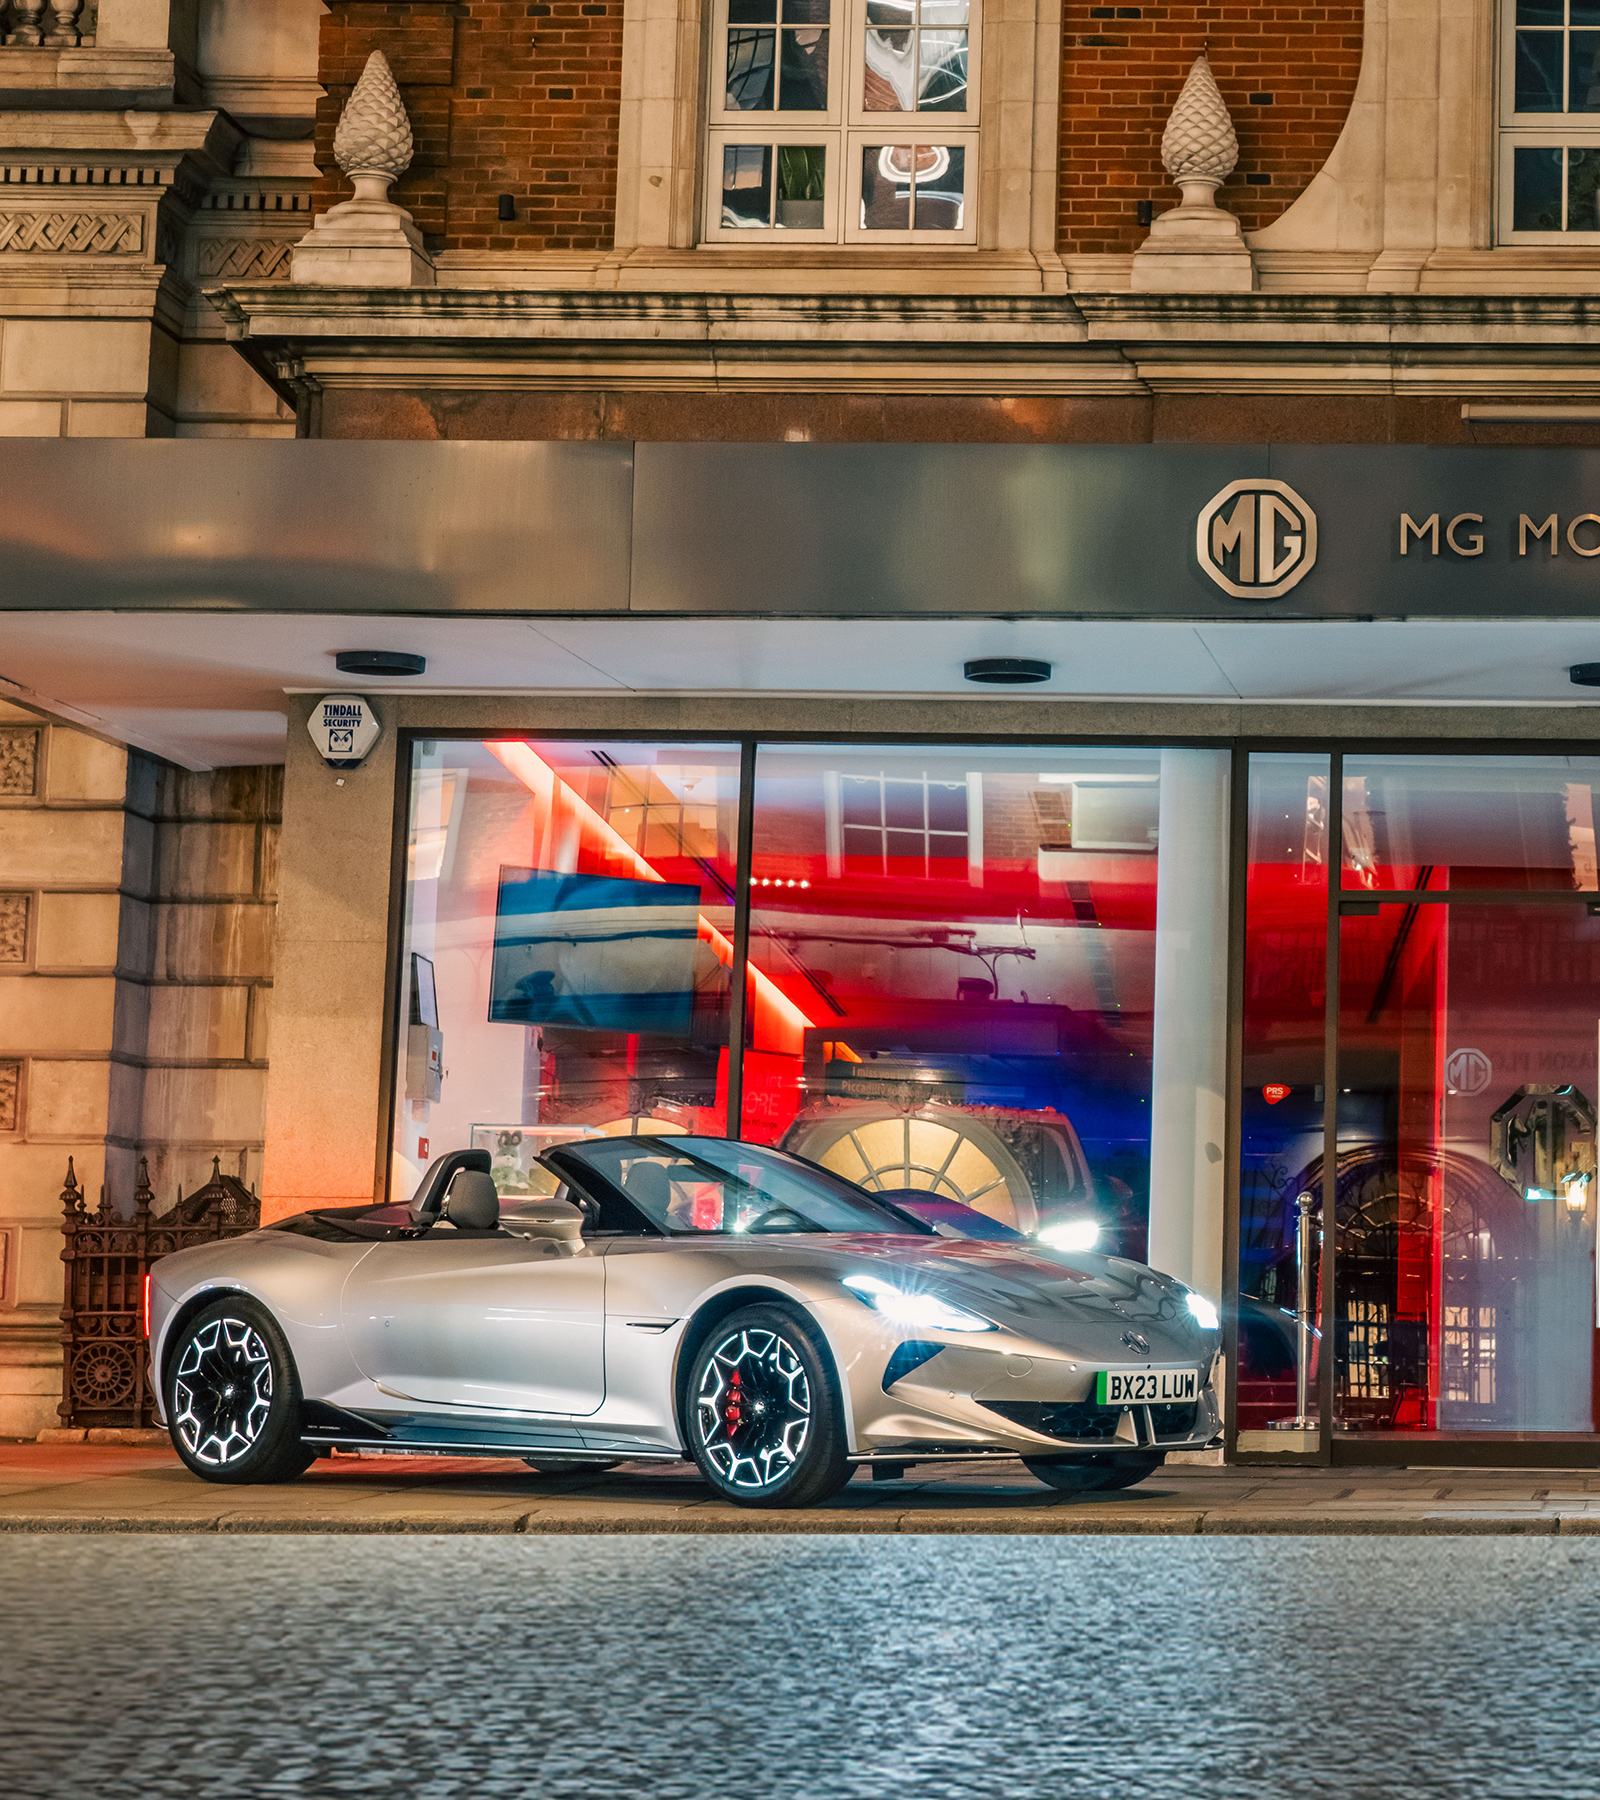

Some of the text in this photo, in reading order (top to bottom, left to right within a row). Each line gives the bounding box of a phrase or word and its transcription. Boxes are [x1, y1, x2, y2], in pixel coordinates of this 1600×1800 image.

[1211, 492, 1305, 585] MG
[1400, 512, 1484, 556] MG
[323, 704, 362, 716] TINDALL
[323, 719, 362, 727] SECURITY
[857, 1067, 877, 1079] miss
[1449, 1053, 1487, 1091] MG
[1266, 1086, 1284, 1095] PRS
[743, 1091, 781, 1116] ORE
[1110, 1374, 1195, 1400] BX23 LUW
